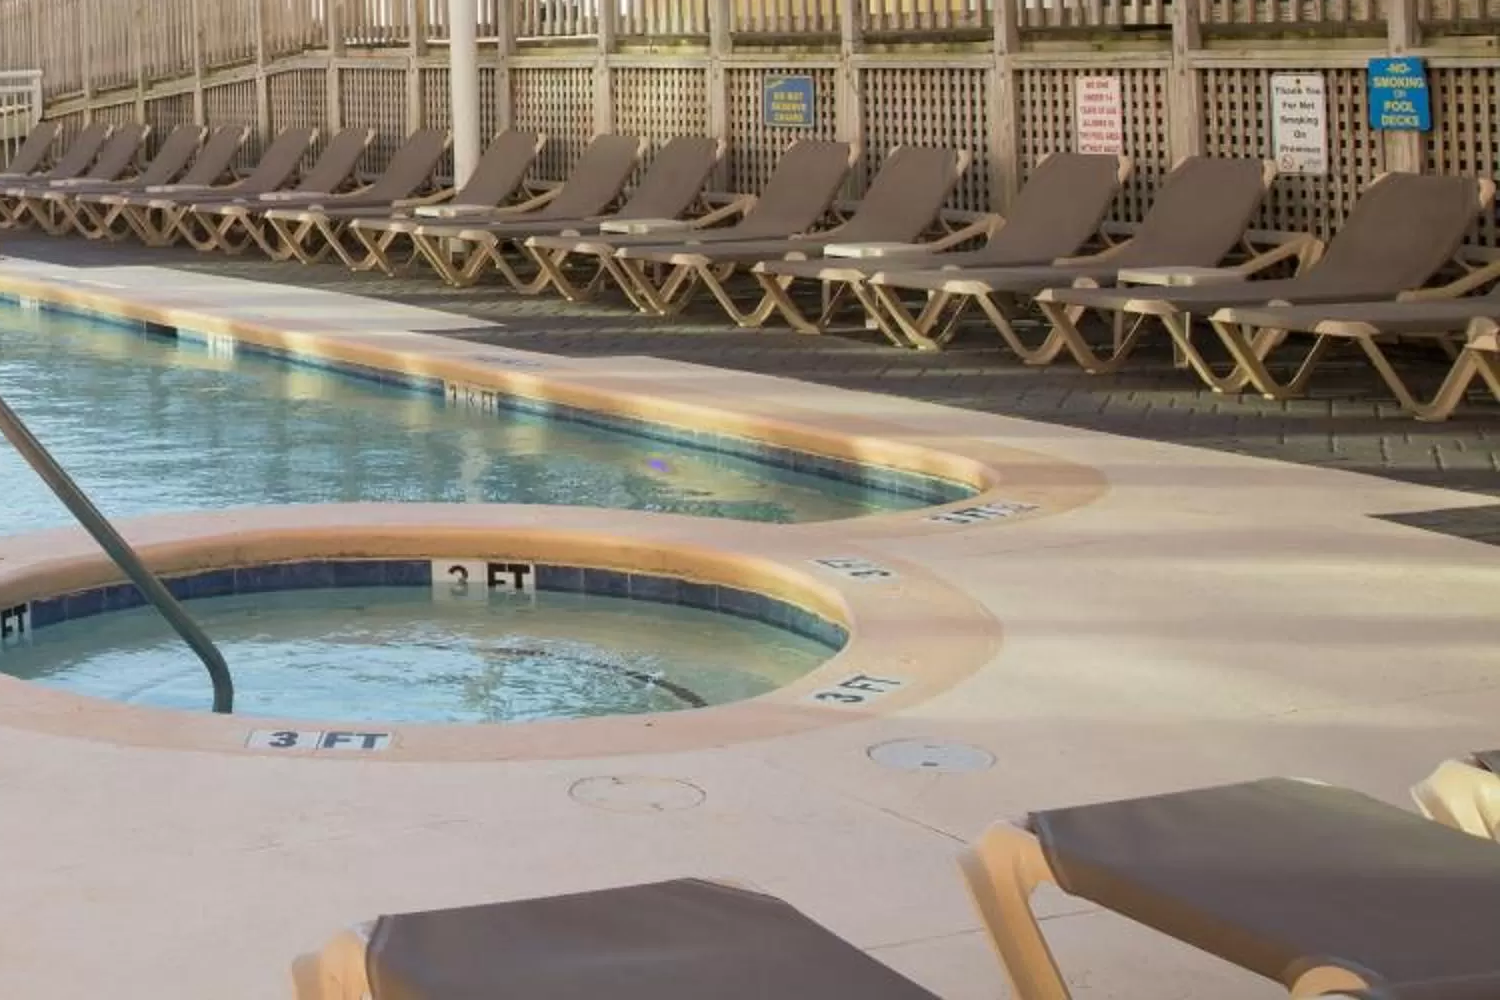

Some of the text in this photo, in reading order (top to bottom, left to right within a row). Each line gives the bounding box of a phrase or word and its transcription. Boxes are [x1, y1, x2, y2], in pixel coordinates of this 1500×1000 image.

[1373, 76, 1425, 89] SMOKING
[1384, 100, 1417, 113] POOL
[1381, 114, 1419, 127] DECKS
[487, 563, 531, 589] FT
[1, 602, 28, 639] FT
[814, 675, 901, 703] 3 FT
[267, 731, 389, 749] 3 FT
